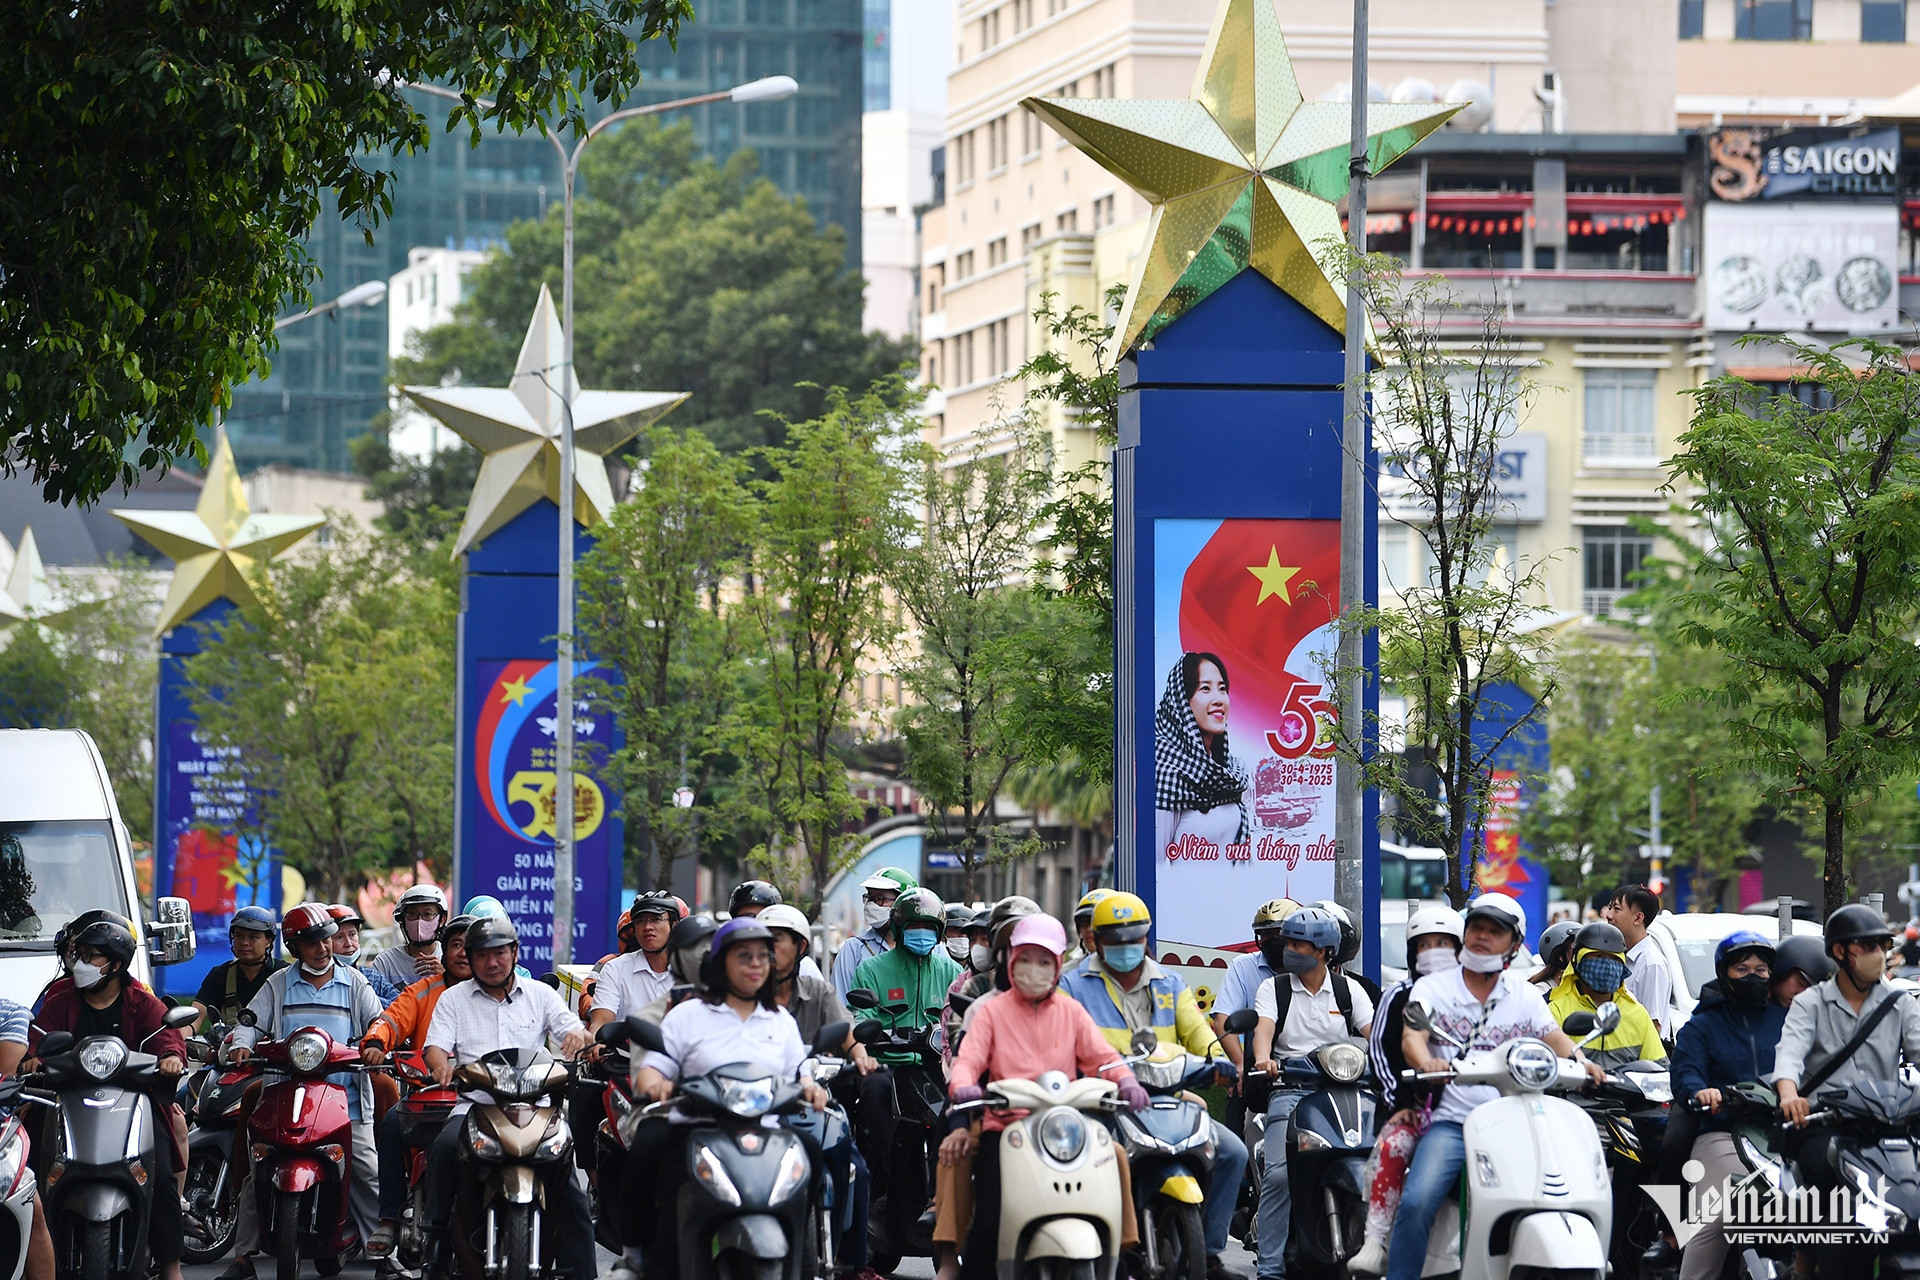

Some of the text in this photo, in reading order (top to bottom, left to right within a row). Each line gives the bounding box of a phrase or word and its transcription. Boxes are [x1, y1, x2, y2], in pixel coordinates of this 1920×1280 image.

[1783, 146, 1897, 175] SAIGON
[1812, 175, 1895, 193] CHILL
[1280, 764, 1333, 775] 30-4-1975
[1280, 775, 1333, 786] 30-4-2025
[514, 850, 554, 868] 50 NĂ
[1166, 834, 1219, 861] Niềm
[1226, 837, 1250, 861] vui
[1257, 834, 1300, 871] thống
[497, 871, 528, 891] GIẢI
[1112, 906, 1133, 919] be
[1152, 987, 1174, 1010] be
